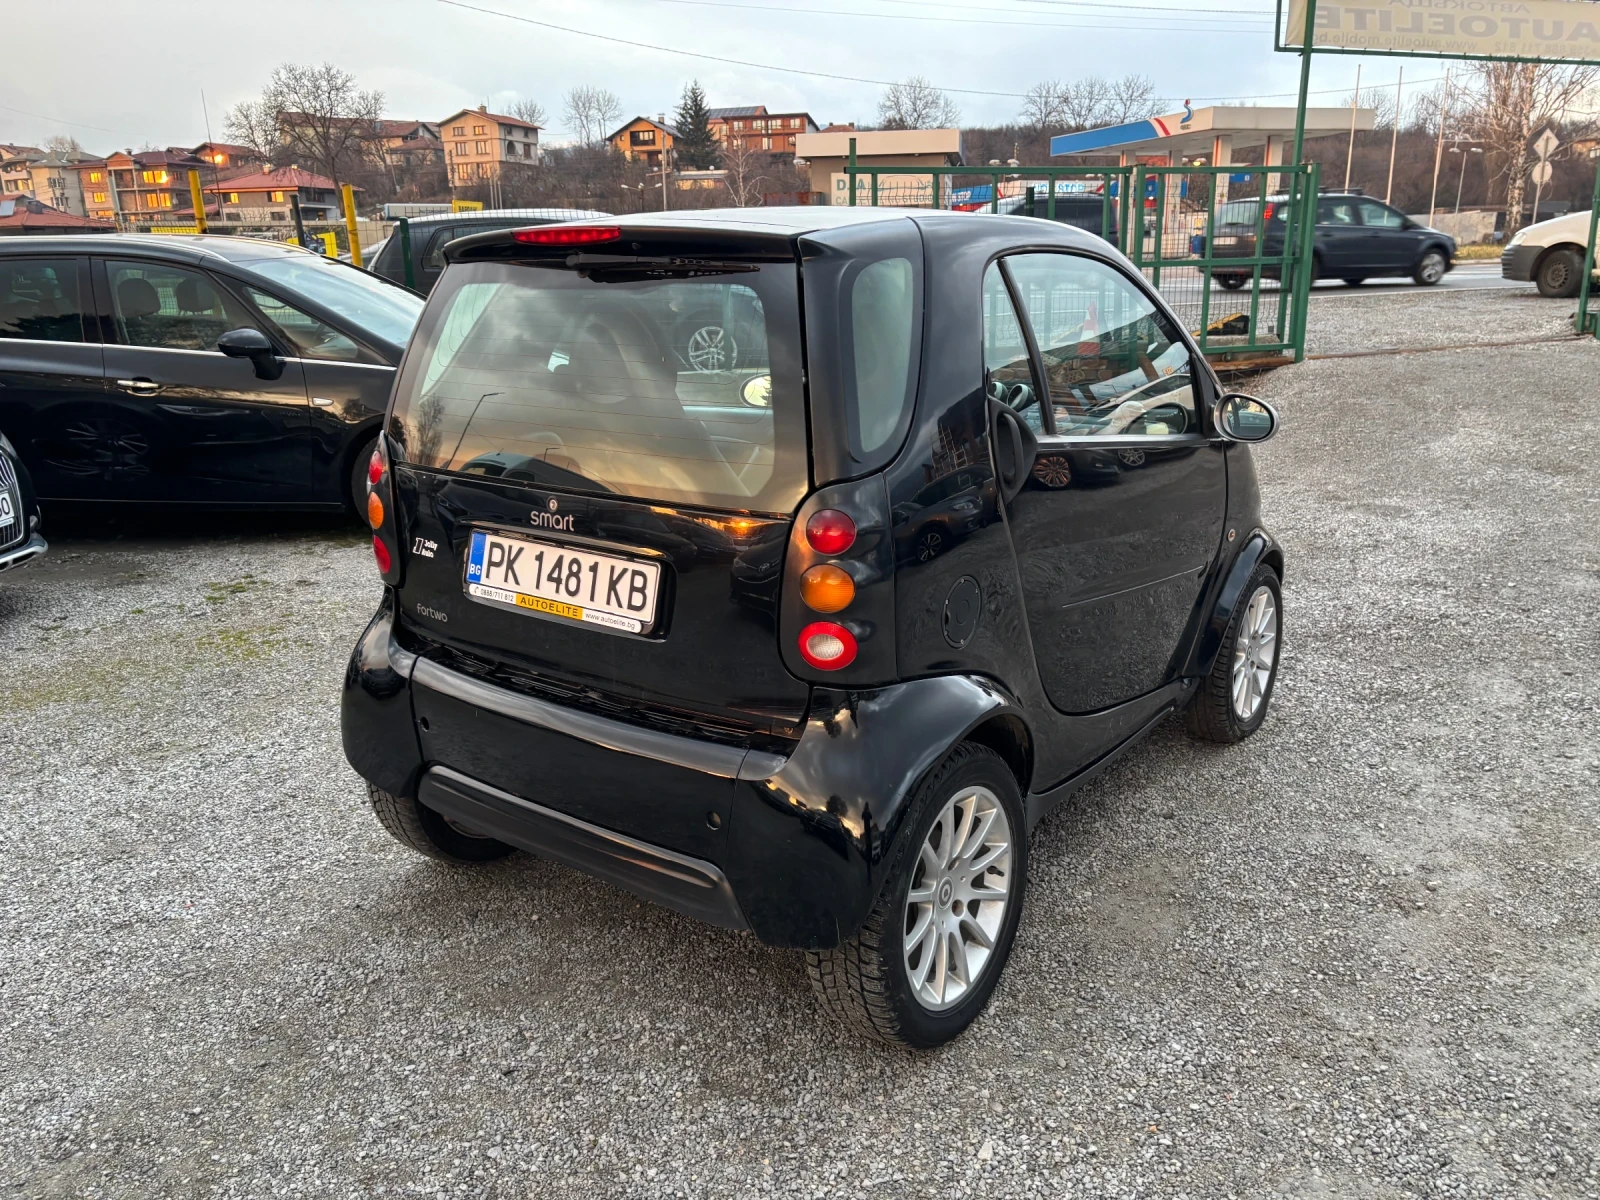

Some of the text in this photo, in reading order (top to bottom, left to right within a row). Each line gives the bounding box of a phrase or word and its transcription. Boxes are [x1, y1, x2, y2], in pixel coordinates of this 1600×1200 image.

[530, 511, 574, 531] smart
[469, 563, 481, 576] BG
[485, 541, 648, 612] PK 1481 KB
[416, 602, 448, 623] fortwo
[520, 596, 578, 617] AUTOELITE
[585, 612, 636, 630] www.autoelite.bg
